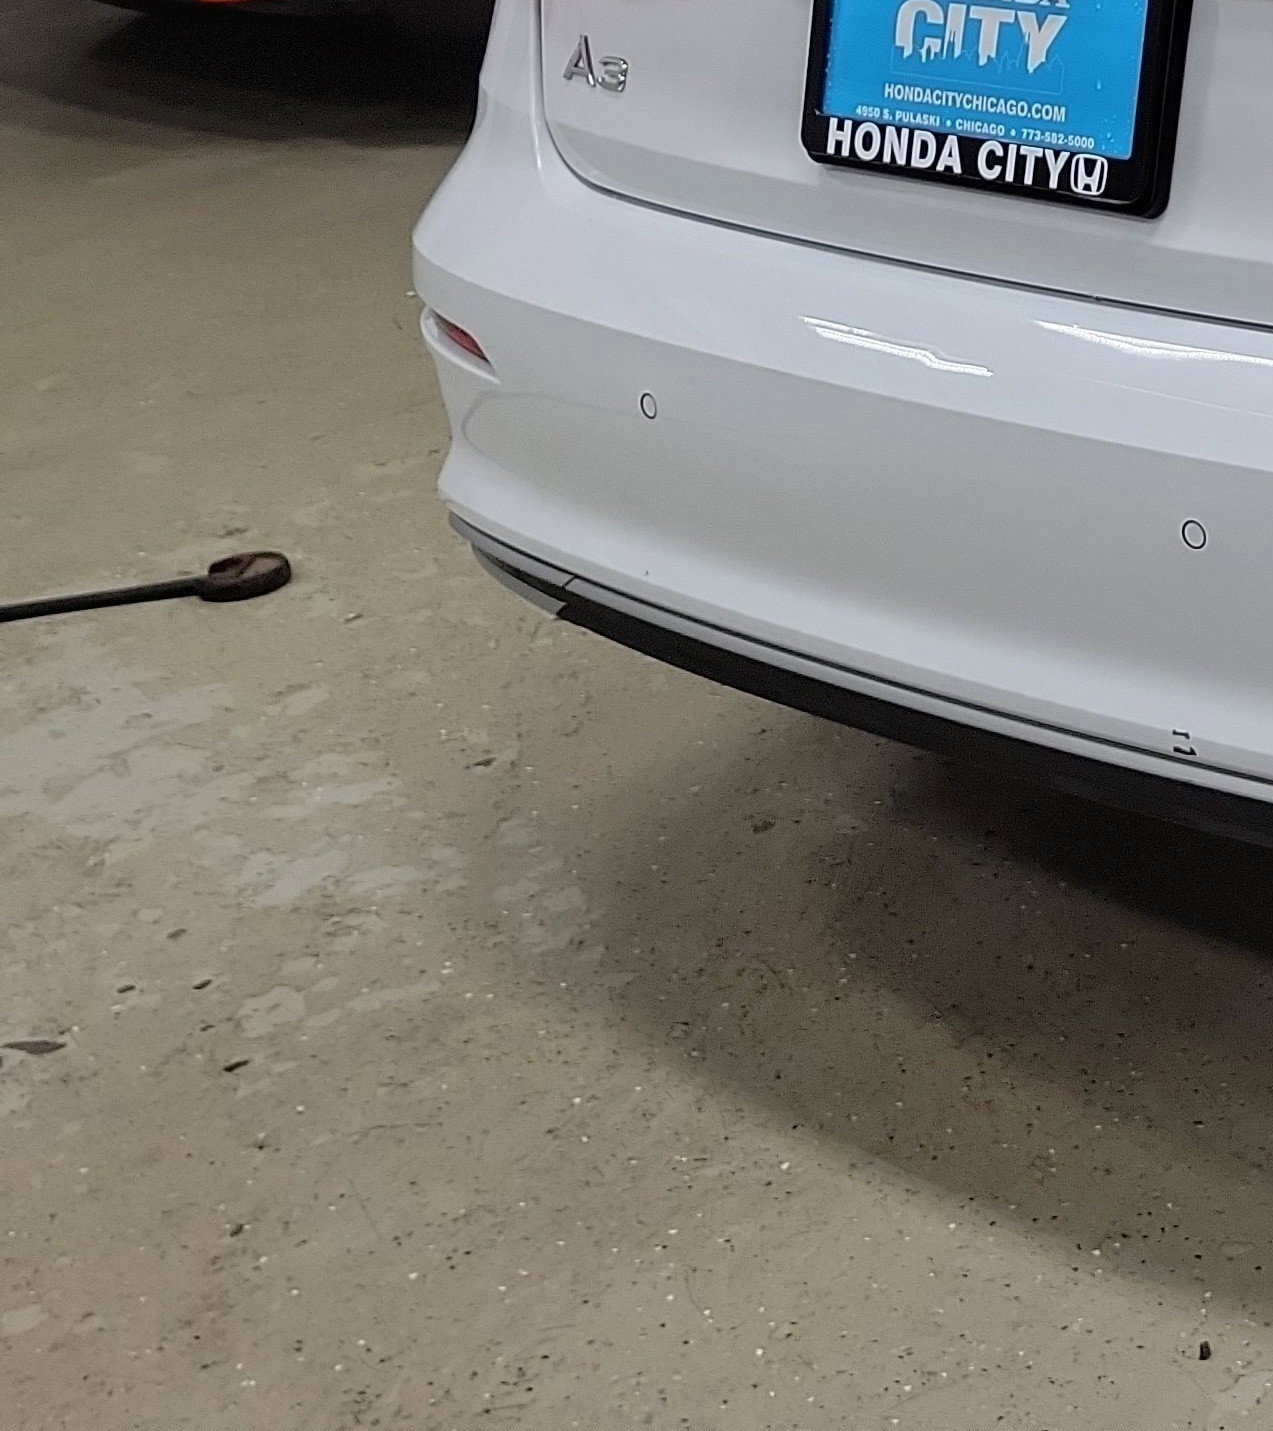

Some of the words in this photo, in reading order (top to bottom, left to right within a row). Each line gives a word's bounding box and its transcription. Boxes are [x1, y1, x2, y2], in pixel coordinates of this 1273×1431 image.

[563, 34, 628, 92] A3
[855, 105, 881, 119] 4950
[883, 108, 893, 120] S.
[895, 110, 940, 127] PULASKI
[955, 119, 1005, 136] CHICAGO
[1021, 128, 1095, 148] 773-582-5000
[884, 83, 1066, 122] HONDACITYCHICAGO.COM
[826, 117, 962, 174] HONDA
[977, 140, 1070, 189] CITY
